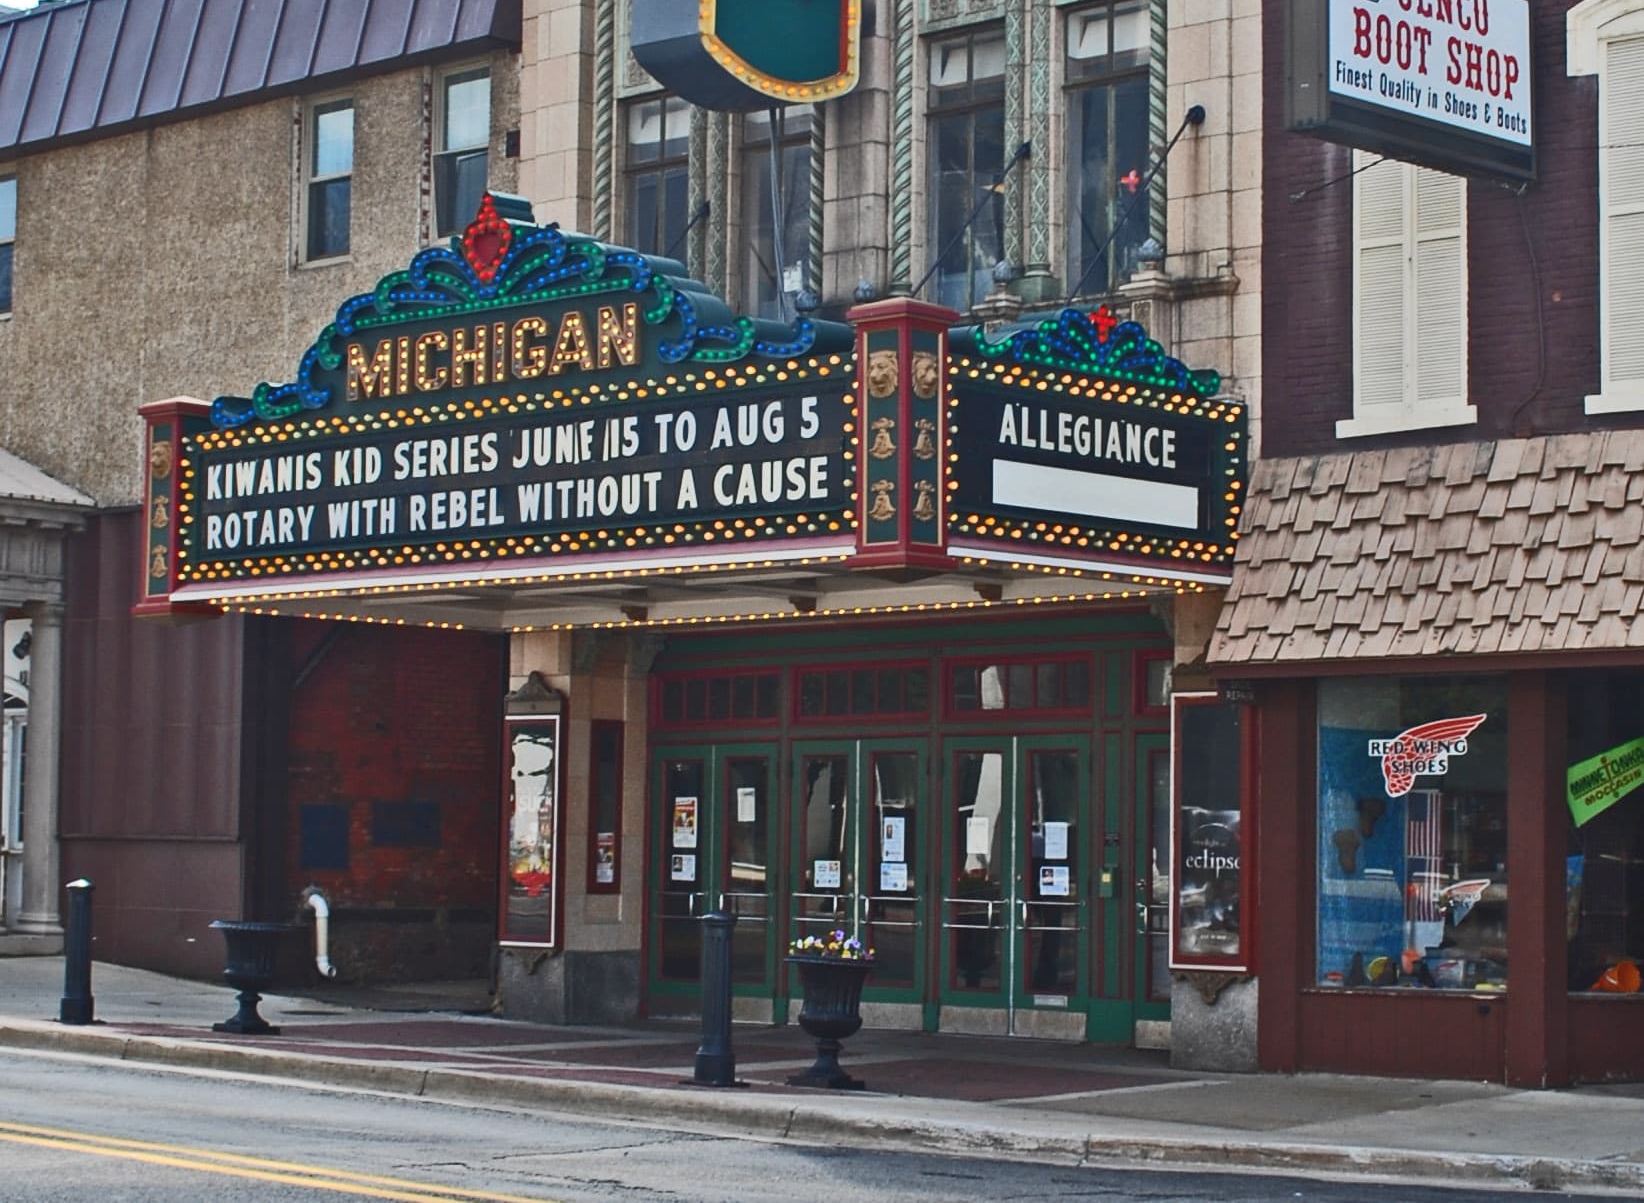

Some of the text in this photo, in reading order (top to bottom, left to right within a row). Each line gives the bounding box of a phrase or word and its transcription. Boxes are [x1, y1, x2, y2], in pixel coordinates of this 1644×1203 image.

[1353, 6, 1519, 101] BOOT SHOP
[1336, 60, 1527, 135] Finest Quality in Shoes & Boots
[347, 303, 637, 401] MICHIGAN
[207, 452, 322, 500] KIWANIS
[334, 446, 382, 487] KID
[393, 432, 498, 480] SERIES
[512, 420, 595, 468] JUNE
[654, 410, 697, 453] TO
[710, 400, 785, 450] AUG
[800, 396, 820, 439] 5
[999, 403, 1176, 469] ALLEGIANCE
[207, 456, 828, 550] ROTARY WITH REBEL WITHOUT A CAUSE
[1370, 740, 1466, 755] RED WING
[1391, 759, 1447, 773] SHOES
[1584, 768, 1642, 807] MOCCASIN
